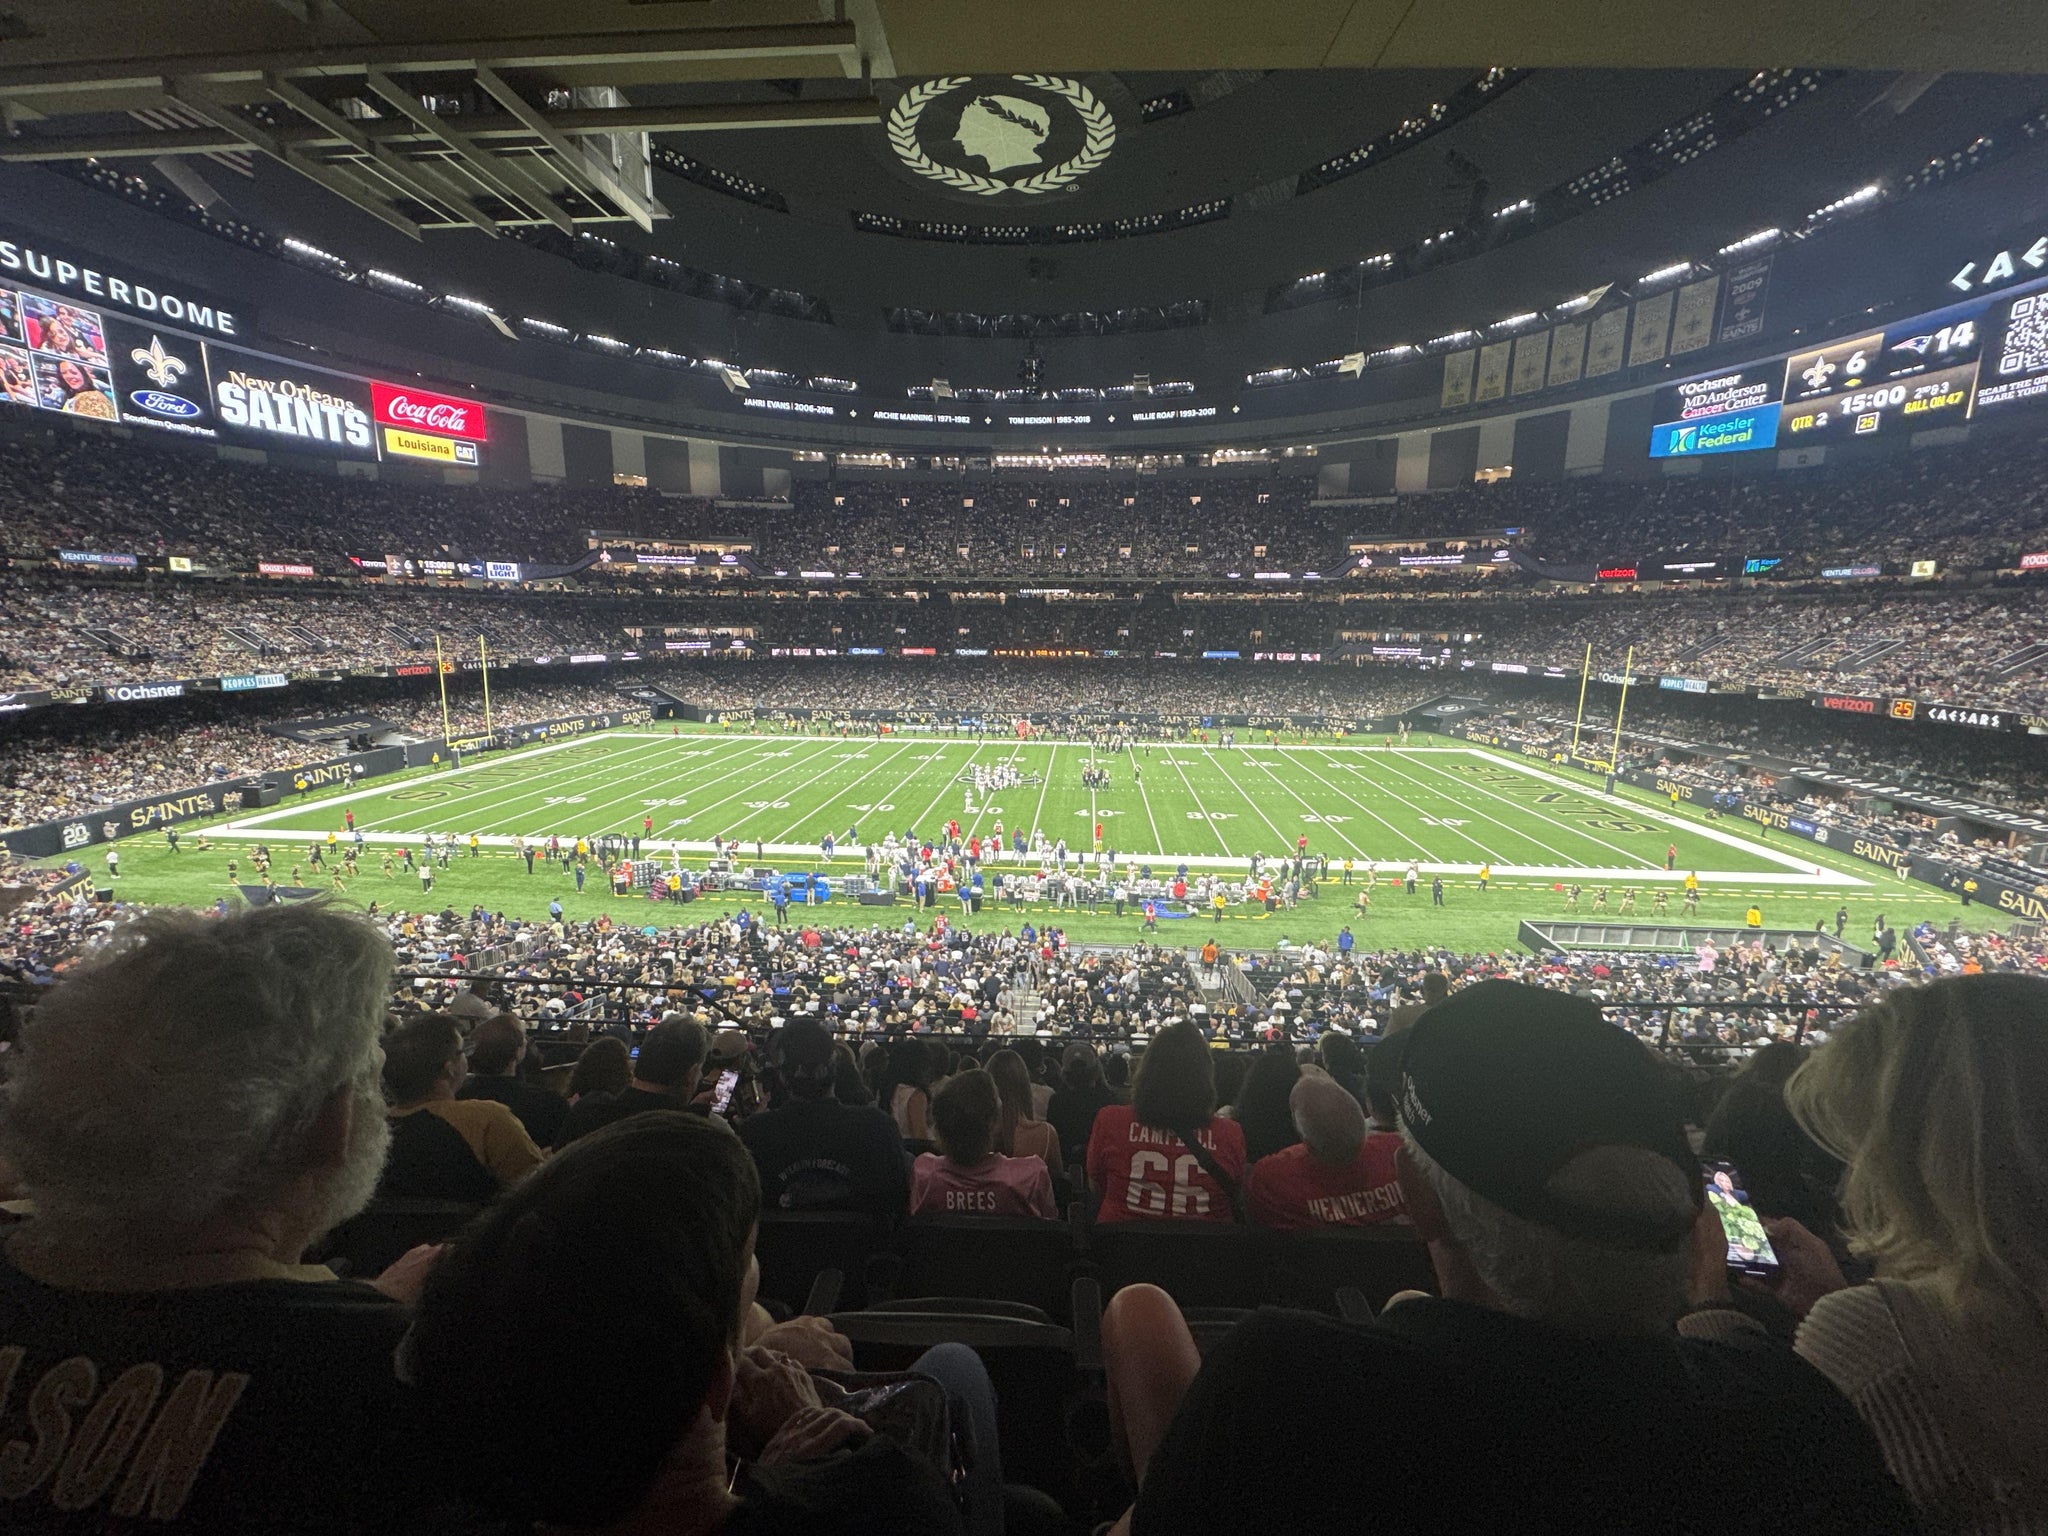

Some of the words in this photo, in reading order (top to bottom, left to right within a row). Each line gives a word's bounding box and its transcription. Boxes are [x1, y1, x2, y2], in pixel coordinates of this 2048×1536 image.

[0, 241, 236, 336] SUPERDOME
[1934, 320, 1975, 353] 14
[1845, 350, 1867, 375] 6
[228, 370, 276, 394] New
[279, 379, 355, 413] Orleans
[1684, 374, 1742, 395] Ochsner
[1978, 384, 2008, 398] SCAN
[2009, 379, 2032, 391] THE
[1840, 385, 1907, 415] 15:00
[1978, 391, 2016, 405] SHARE
[2017, 384, 2047, 398] YOUR
[145, 393, 187, 414] Ford
[743, 398, 766, 407] JAHRI
[767, 401, 790, 410] EVANS
[794, 402, 834, 415] 2006-2016
[1681, 402, 1725, 419] Cancer
[1724, 394, 1767, 411] Center
[1904, 401, 1928, 414] BALL
[1929, 396, 1946, 408] ON
[1946, 391, 1963, 404] 47
[216, 381, 371, 448] SAINTS
[873, 411, 899, 420] ARCHIE
[900, 412, 933, 422] MANNING
[937, 415, 970, 424] 1971-1982
[1008, 416, 1024, 424] TOM
[1025, 416, 1052, 424] BENSON
[1056, 416, 1091, 424] 1985-2018
[1132, 413, 1156, 421] WILLIE
[1156, 411, 1175, 420] ROAF
[1179, 407, 1216, 417] 1993-2001
[1791, 415, 1814, 432] QTR
[1815, 411, 1829, 427] 2
[123, 412, 164, 427] Southern
[164, 420, 194, 433] Quality
[195, 426, 216, 437] Ford
[1699, 417, 1755, 436] Keesler
[1859, 416, 1874, 429] 25
[398, 436, 450, 455] Louisiana
[1697, 428, 1753, 449] Federal
[455, 445, 474, 460] CAT
[61, 552, 102, 562] VENTURE
[103, 556, 135, 564] GLOBAL
[362, 560, 387, 568] TOYOTA
[404, 560, 412, 570] 6
[424, 560, 446, 569] 15:00
[261, 564, 286, 573] ROUSES
[286, 565, 314, 575] MARKETS
[458, 562, 471, 573] 14
[489, 570, 516, 578] LIGHT
[1599, 568, 1635, 578] verizon
[1822, 569, 1852, 577] VENTURE
[1852, 566, 1878, 575] GLOBAL
[350, 667, 375, 676] SAINTS
[396, 665, 431, 676] verizon
[442, 662, 452, 672] 25
[223, 677, 256, 689] PEOPLES
[257, 676, 284, 686] HEALTH
[292, 671, 319, 680] SAINTS
[1661, 678, 1683, 689] PEOPLES
[1684, 680, 1707, 692] HEALTH
[1721, 683, 1745, 692] SAINTS
[50, 687, 94, 700] SAINTS
[117, 685, 182, 701] Ochsner
[1777, 689, 1805, 698] SAINTS
[1823, 697, 1874, 713] verizon
[1894, 701, 1913, 717] 25
[622, 711, 650, 723] SAINTS
[720, 709, 754, 720] SAINTS
[811, 709, 851, 720] SAINTS
[896, 711, 936, 722] SAINTS
[981, 713, 1022, 723] SAINTS
[1069, 714, 1111, 725] SAINTS
[1158, 715, 1201, 726] SAINTS
[1247, 717, 1291, 727] SAINTS
[1928, 707, 2000, 727] CAESARS
[549, 720, 584, 735] SAINTS
[1466, 731, 1490, 745] SAINTS
[1521, 743, 1548, 758] SAINTS
[1656, 779, 1693, 799] SAINTS
[131, 793, 208, 829] SAINTS
[1743, 805, 1789, 829] SAINTS
[64, 826, 90, 845] 20
[1853, 840, 1905, 868] SAINT
[1126, 1150, 1211, 1216] 66
[946, 1190, 997, 1210] BREES
[0, 1344, 250, 1520] SON
